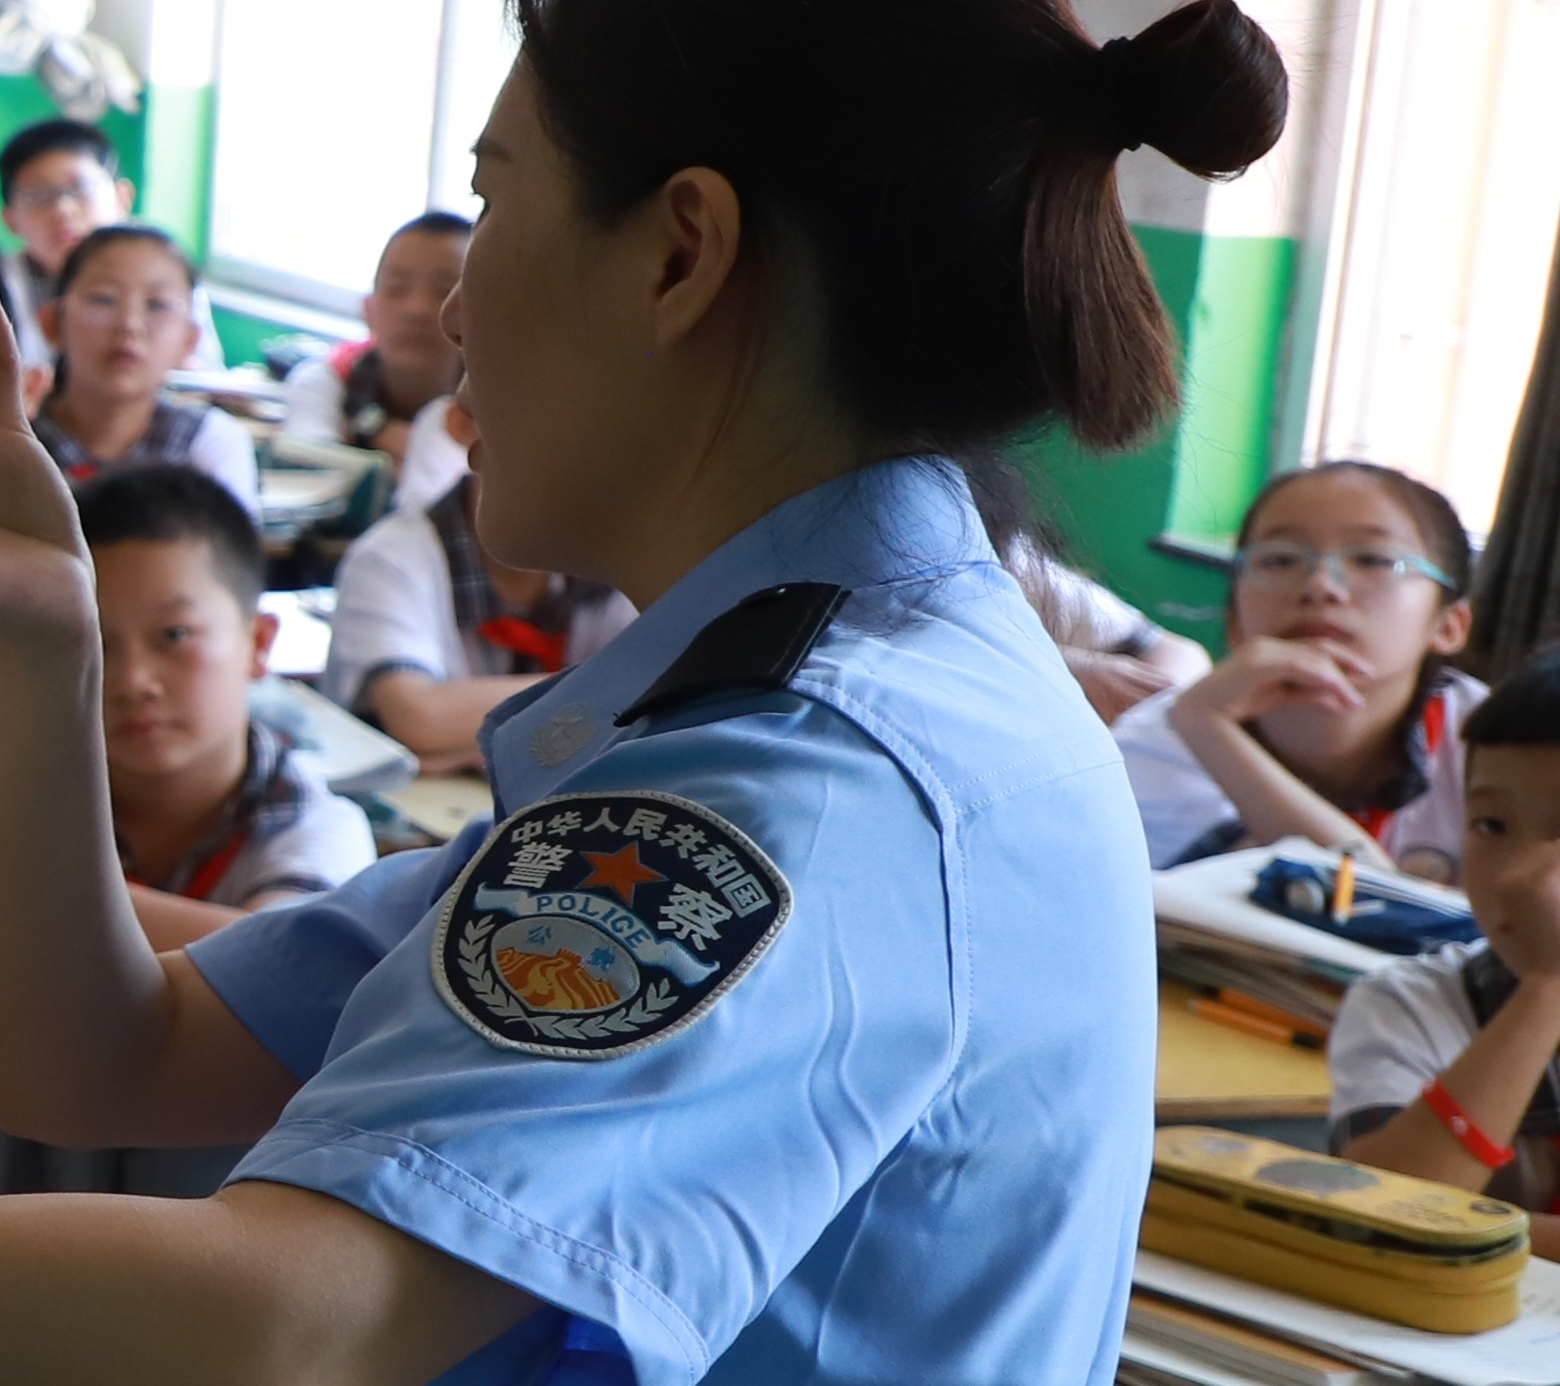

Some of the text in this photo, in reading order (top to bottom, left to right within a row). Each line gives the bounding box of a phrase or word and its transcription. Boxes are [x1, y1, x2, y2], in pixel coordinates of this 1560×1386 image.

[510, 806, 772, 919] 中华人民共和国
[536, 894, 652, 949] POLICE
